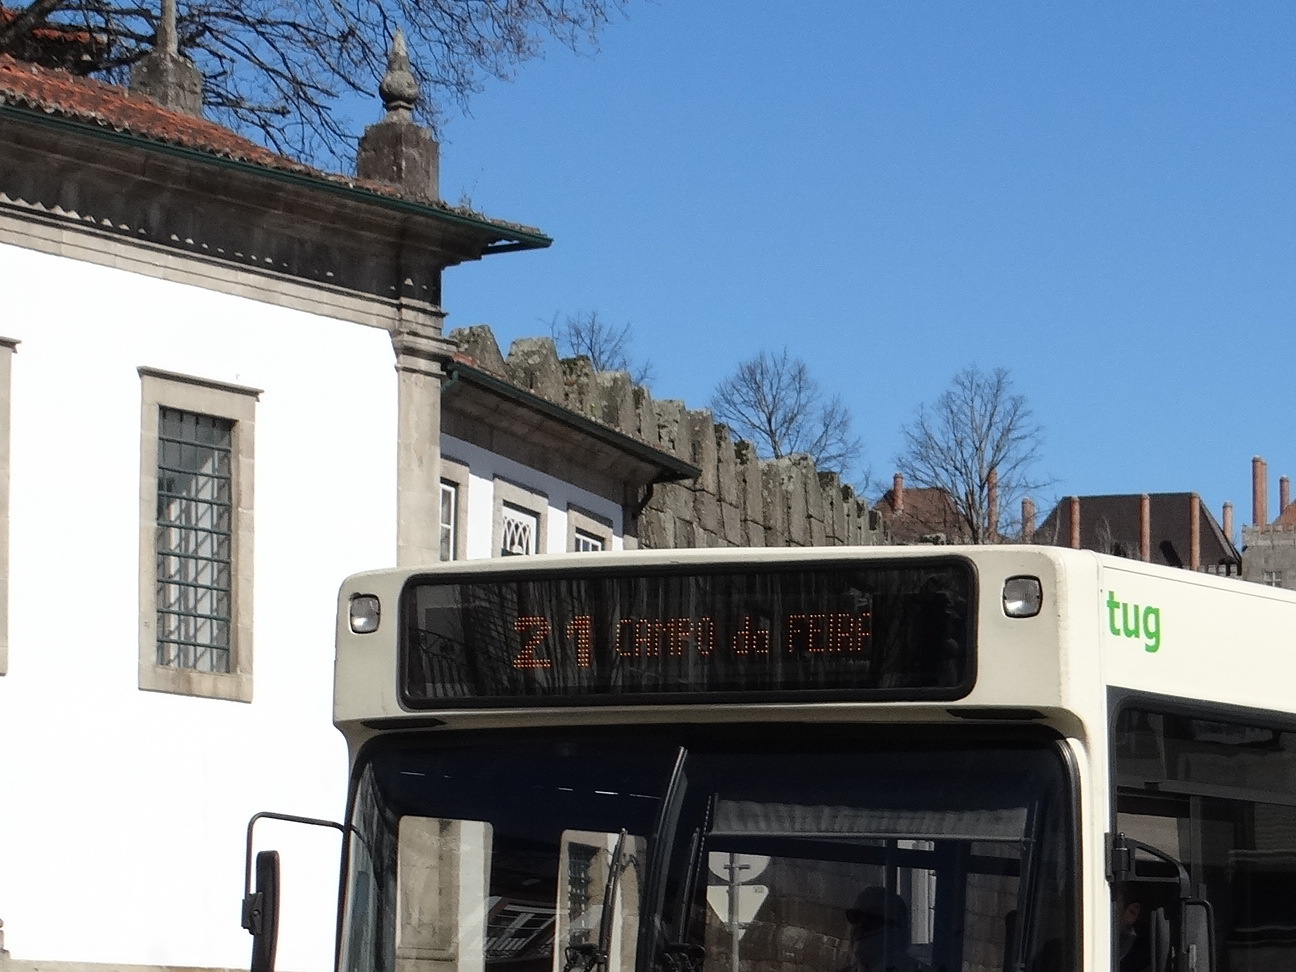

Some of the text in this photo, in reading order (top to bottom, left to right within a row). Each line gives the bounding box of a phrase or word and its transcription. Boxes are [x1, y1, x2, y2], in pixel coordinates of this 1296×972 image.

[513, 615, 593, 669] 21
[614, 616, 714, 657] CAMPO
[732, 616, 770, 655] da
[1106, 591, 1160, 653] tug
